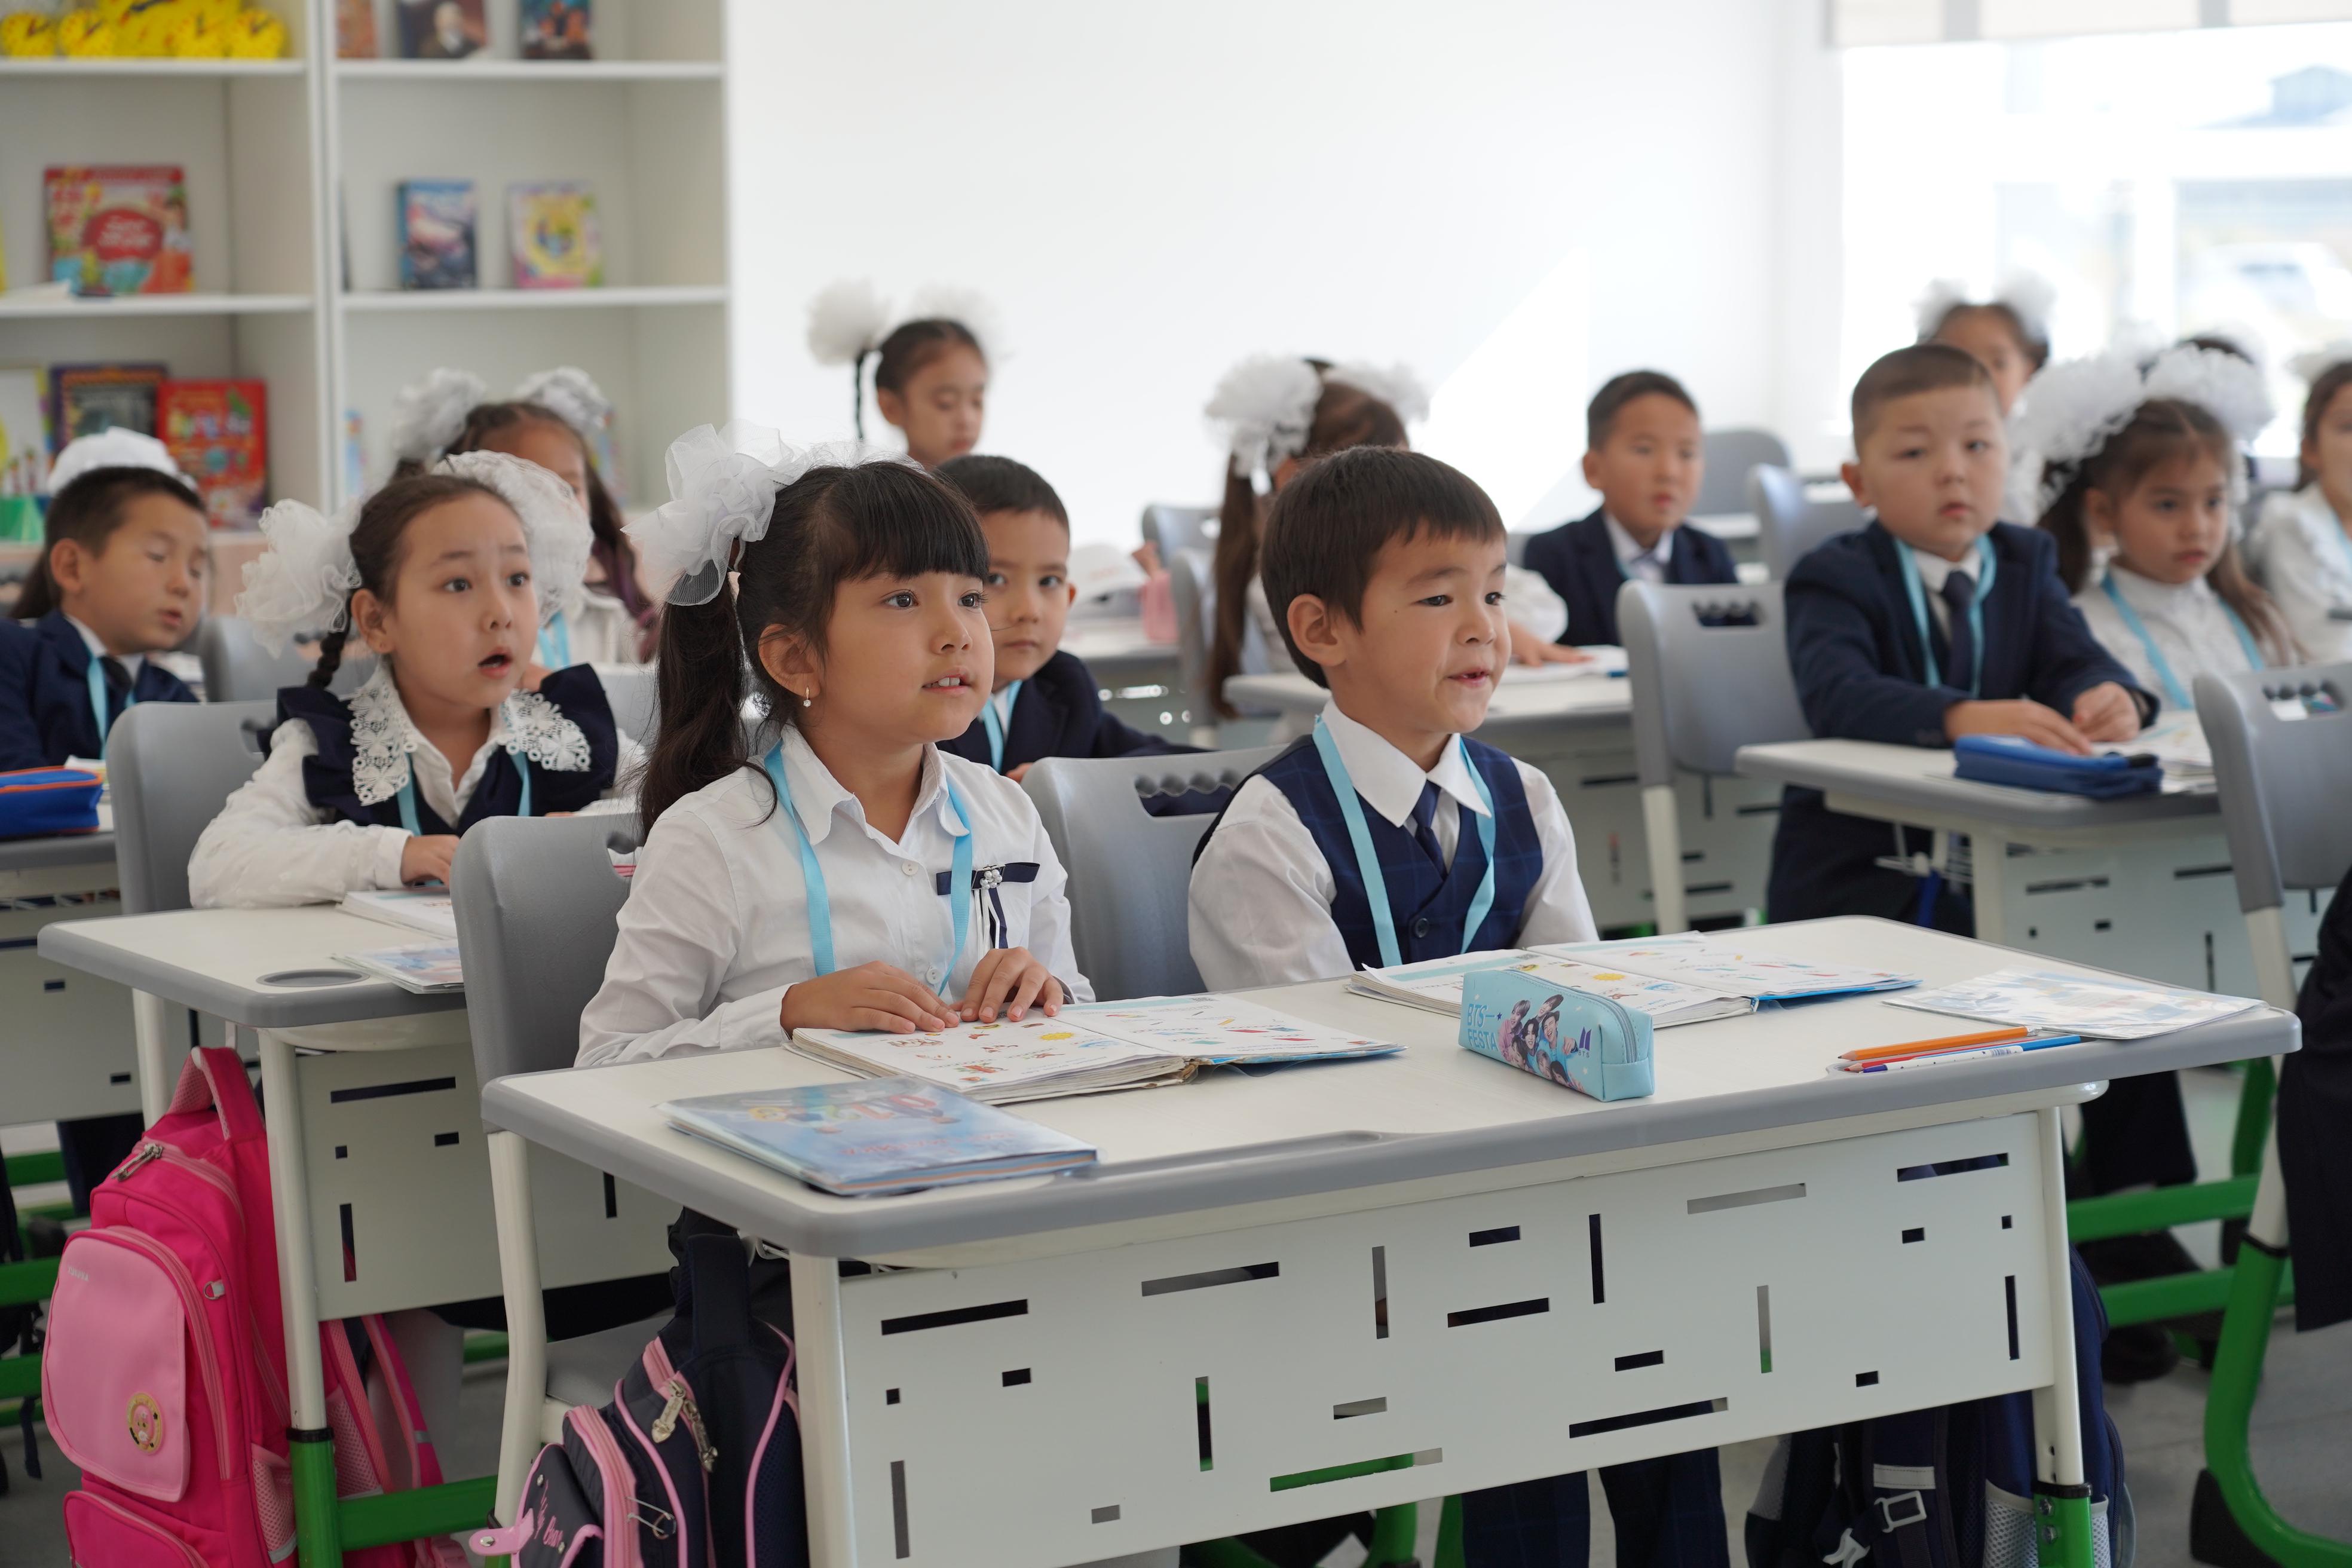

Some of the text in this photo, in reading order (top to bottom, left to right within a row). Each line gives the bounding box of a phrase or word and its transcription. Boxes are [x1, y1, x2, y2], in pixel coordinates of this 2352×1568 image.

[1467, 1003, 1488, 1028] BTS
[1467, 1028, 1499, 1052] FESTA
[1578, 1050, 1590, 1058] BTS
